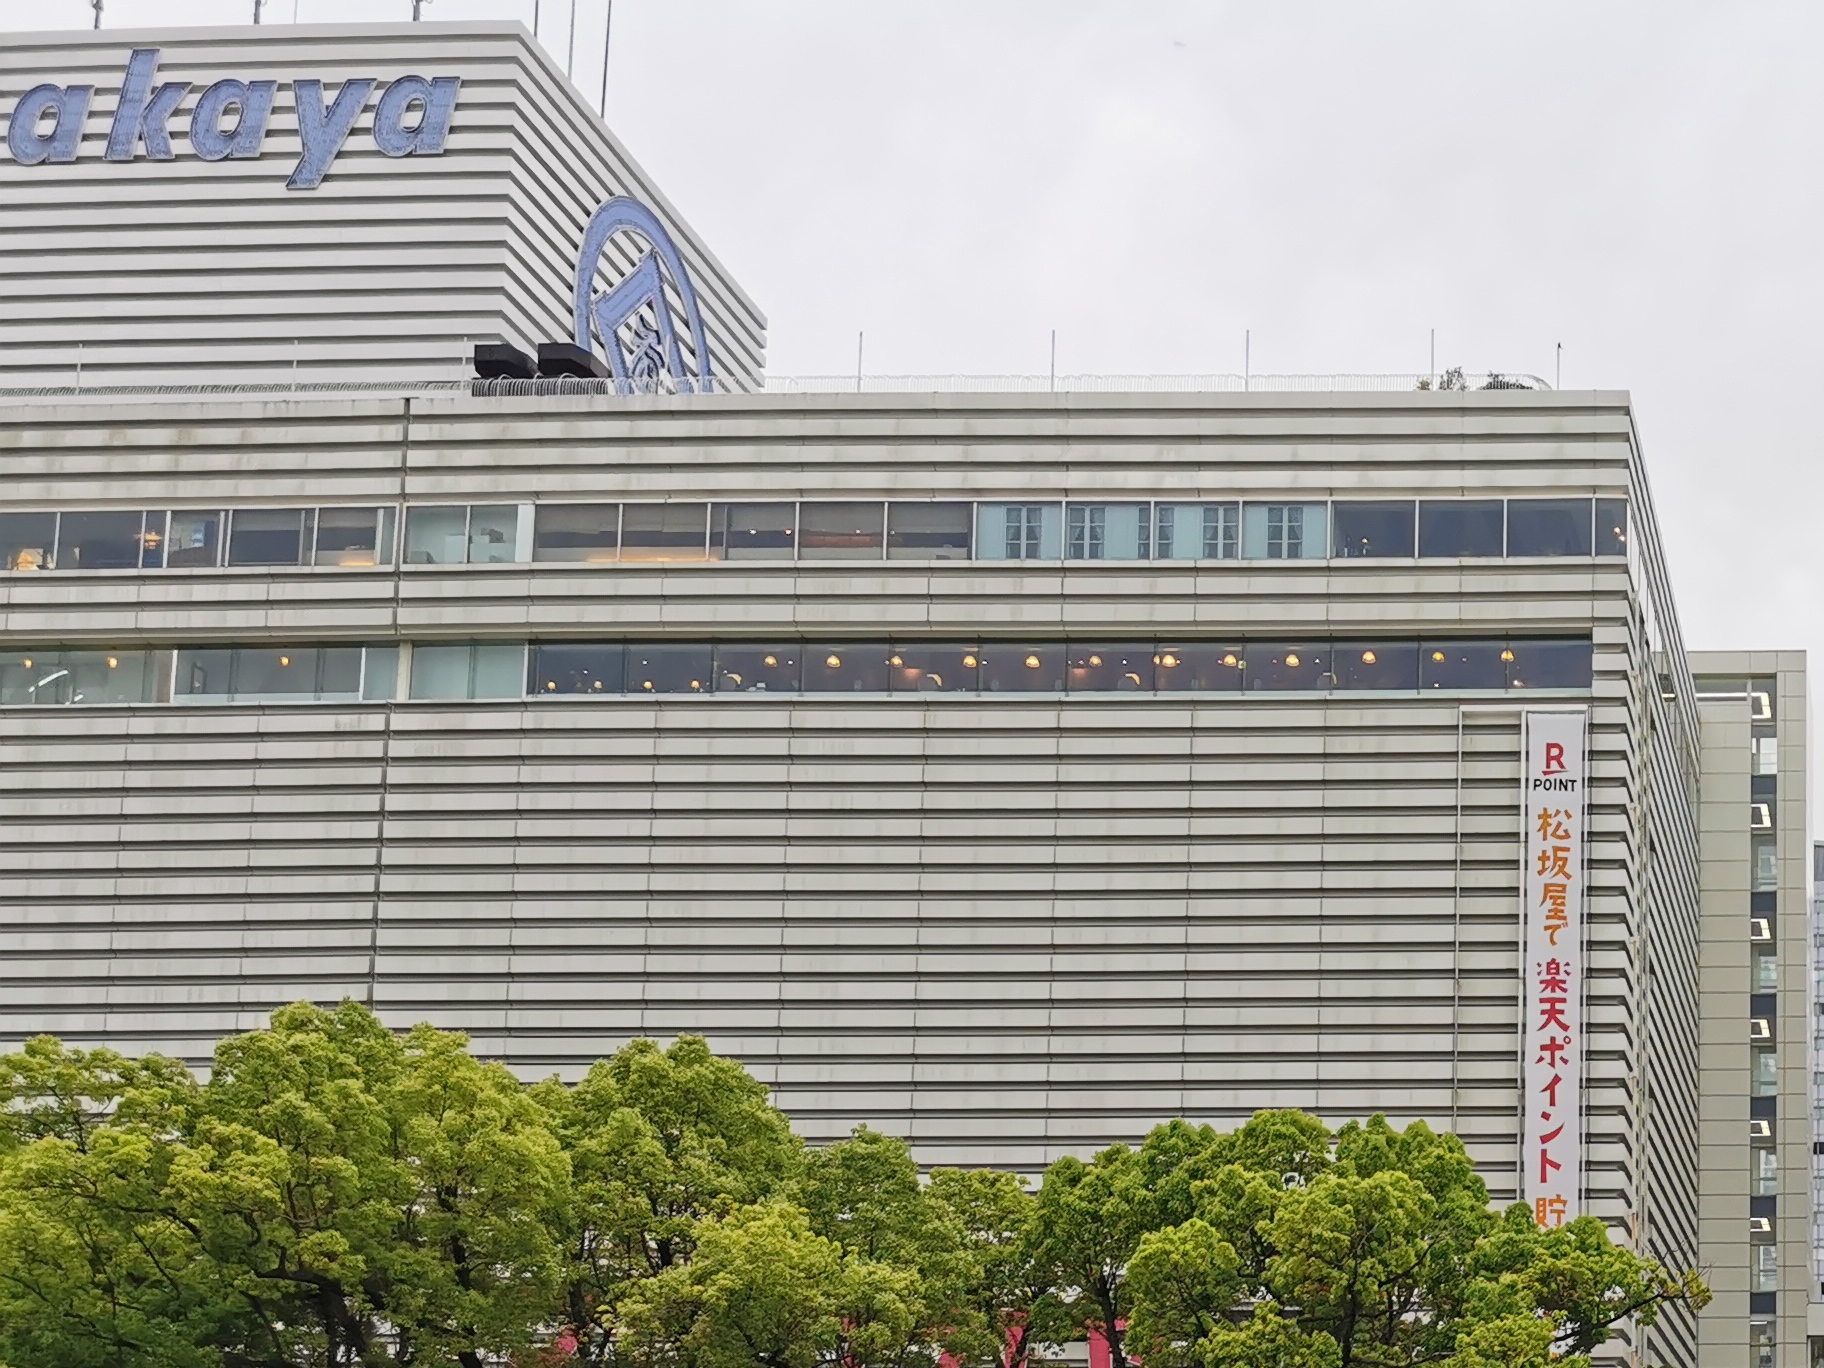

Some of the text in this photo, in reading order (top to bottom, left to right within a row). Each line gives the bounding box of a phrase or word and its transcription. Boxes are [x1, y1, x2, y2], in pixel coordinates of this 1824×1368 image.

[8, 48, 462, 190] akaya
[1542, 742, 1568, 775] R
[1532, 777, 1577, 793] POINT
